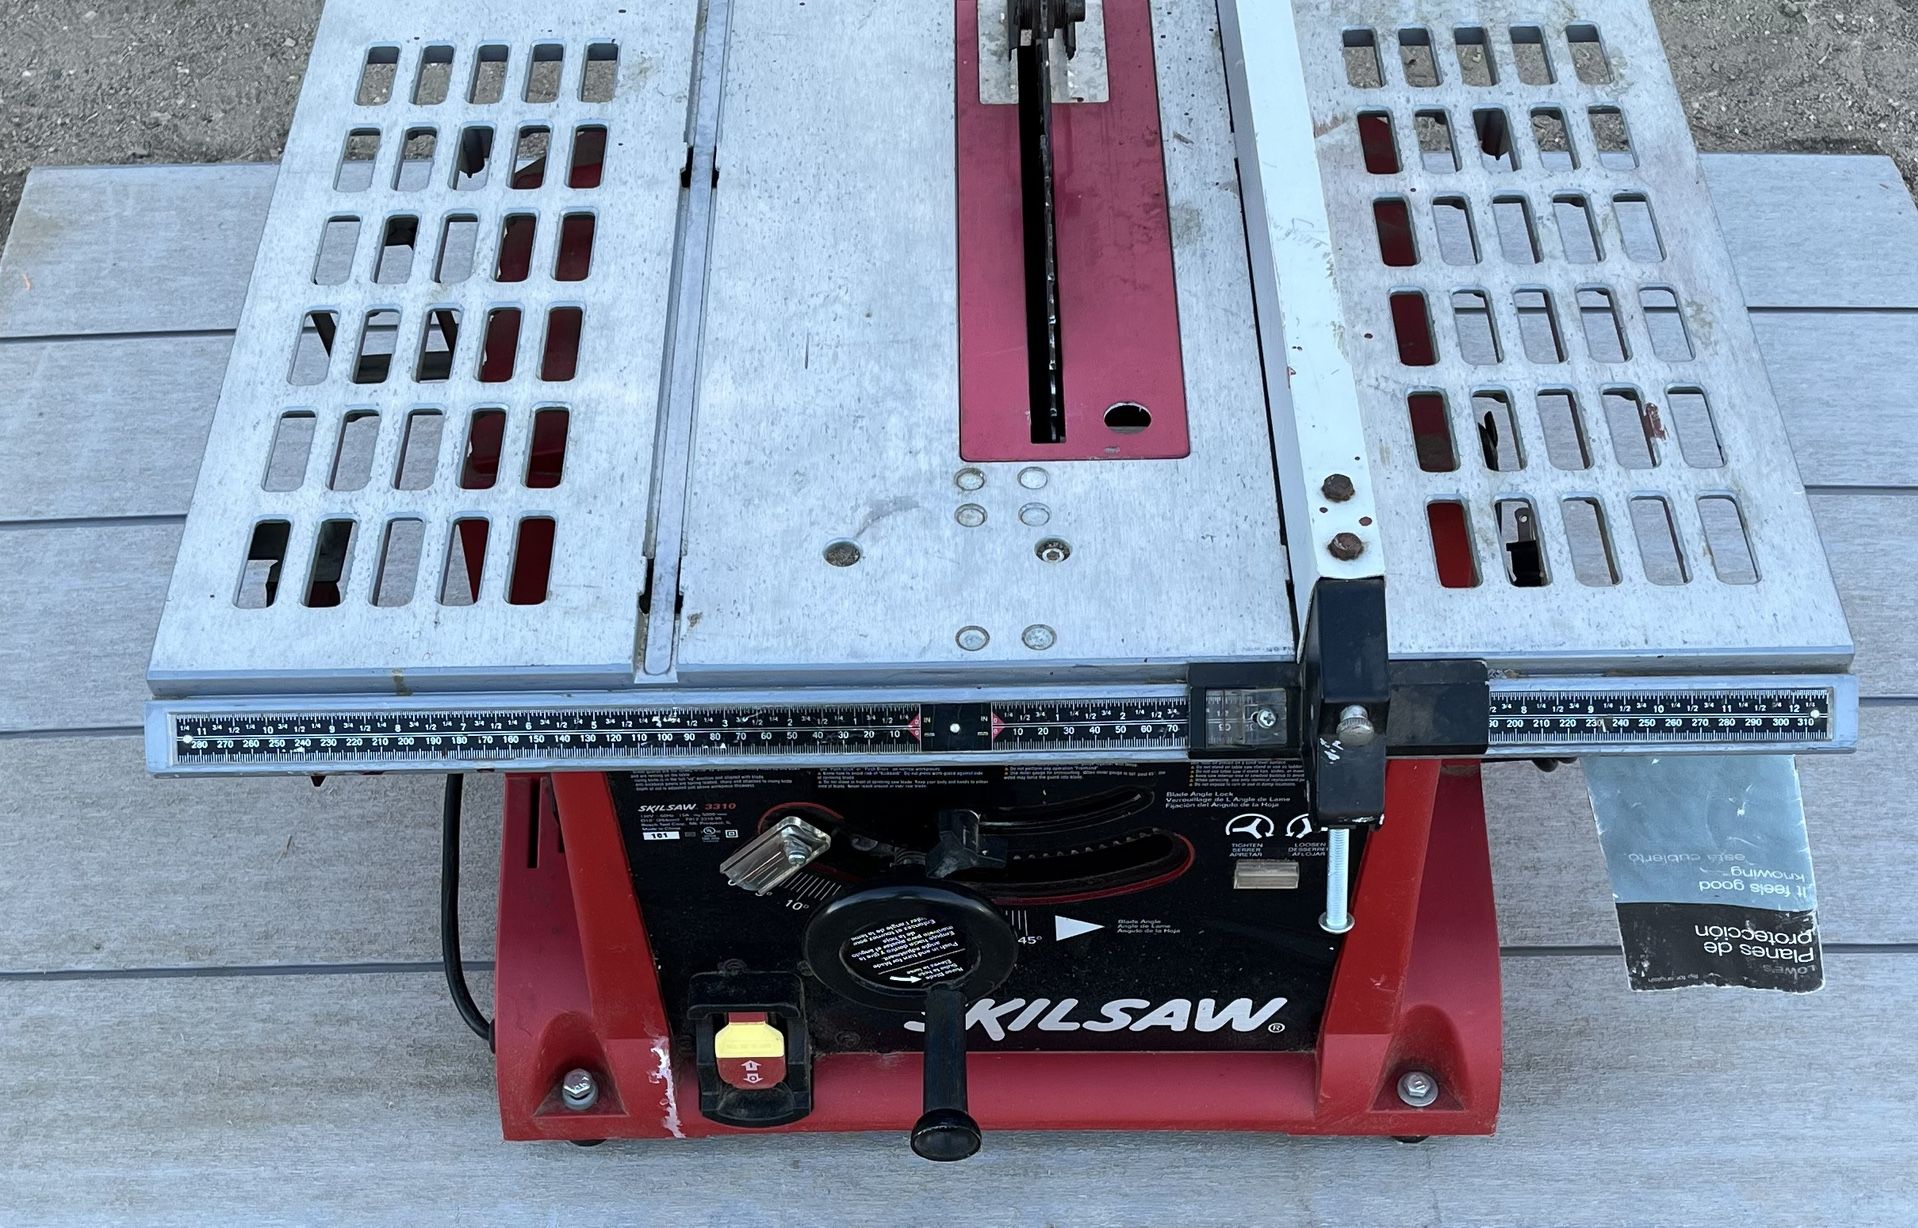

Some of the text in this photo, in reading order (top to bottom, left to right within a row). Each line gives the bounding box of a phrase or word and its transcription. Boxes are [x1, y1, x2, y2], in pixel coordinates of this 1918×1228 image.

[1613, 719, 1629, 727] 240
[1038, 727, 1049, 735] 20
[1089, 726, 1100, 734] 40
[1141, 725, 1152, 733] 60
[192, 740, 208, 748] 280
[217, 740, 233, 748] 270
[243, 740, 259, 748] 260
[269, 739, 285, 747] 250
[295, 739, 311, 747] 240
[321, 738, 337, 746] 230
[346, 738, 362, 746] 220
[372, 737, 388, 745] 210
[398, 737, 414, 745] 200
[426, 737, 442, 745] 190
[503, 736, 519, 744] 160
[529, 735, 544, 743] 150
[555, 735, 570, 743] 140
[606, 734, 622, 742] 120
[736, 732, 746, 740] 70
[761, 732, 772, 740] 60
[813, 731, 823, 739] 40
[638, 804, 696, 813] SKILSAW
[1699, 880, 1807, 897] It feels good
[1695, 925, 1812, 945] protección
[940, 941, 958, 949] Push
[1703, 941, 1813, 963] Planes de
